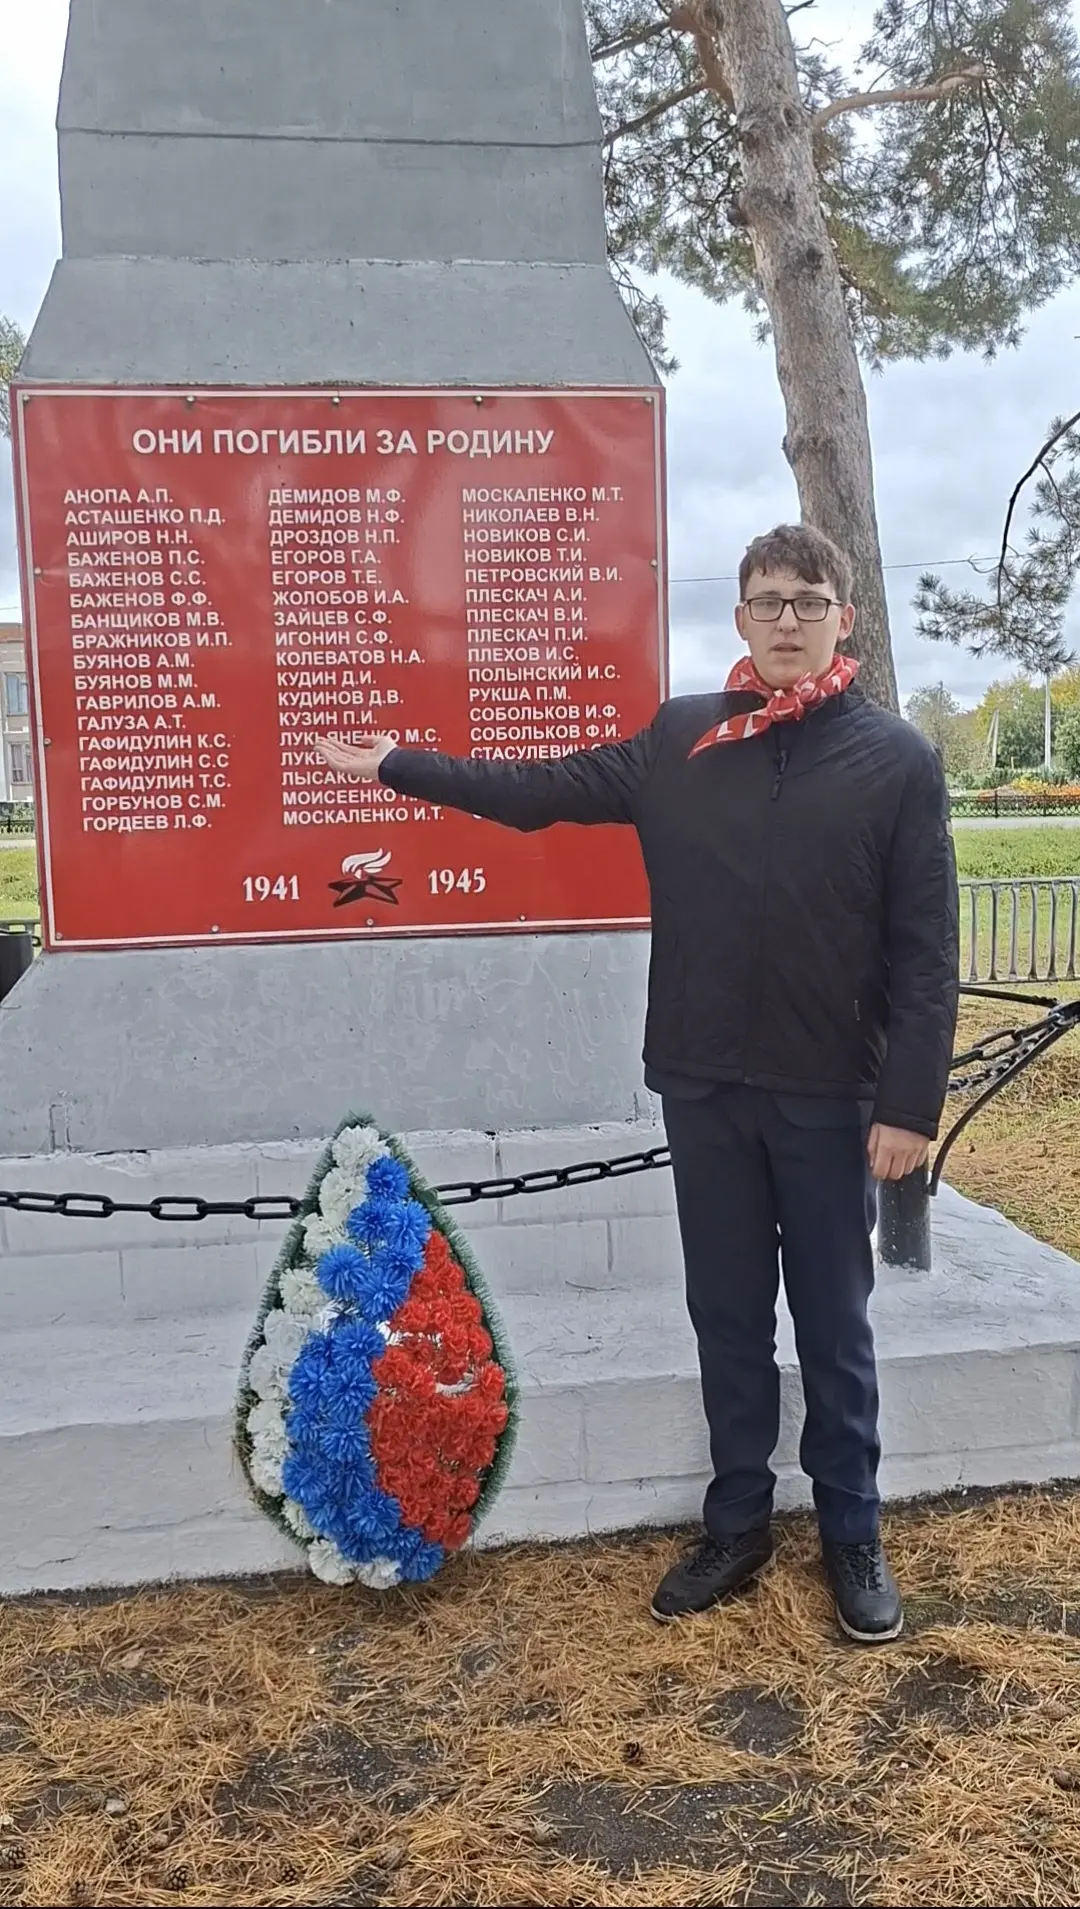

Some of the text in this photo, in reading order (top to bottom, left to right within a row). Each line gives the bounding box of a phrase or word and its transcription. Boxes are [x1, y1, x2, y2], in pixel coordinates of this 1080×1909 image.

[132, 429, 555, 458] ОНИ ПОГИБЛИ ЗА РОДИНУ
[63, 488, 174, 504] АНОПА А.П.
[268, 488, 406, 506] ДЕМИДОВ М.Ф.
[462, 486, 624, 503] МОСКАЛЕНКО М.Т.
[64, 508, 226, 526] АСТАШЕНКО П.Д.
[269, 509, 405, 526] ДЕМИДОВ Н.Ф.
[463, 507, 600, 523] НИКОЛАЕВ В.Н.
[66, 529, 193, 547] АШИРОВ Н.Н.
[270, 529, 400, 547] ДРОЗДОВ Н.П.
[463, 527, 591, 543] НОВИКОВ С.И.
[67, 550, 205, 567] БАЖЕНОВ П.С.
[271, 550, 382, 565] ЕГОРОВ Г.А.
[464, 548, 588, 564] НОВИКОВ Т.И.
[68, 570, 207, 588] БАЖЕНОВ С.С.
[272, 570, 383, 585] ЕГОРОВ Т.Е.
[465, 564, 623, 583] ПЕТРОВСКИЙ В.И.
[70, 591, 212, 608] БАЖЕНОВ Ф.Ф.
[272, 589, 409, 606] ЖОЛОБОВ И.А.
[465, 587, 588, 603] ПЛЕСКАЧ А.И.
[71, 611, 225, 630] БАНЩИКОВ М.В.
[273, 607, 392, 627] ЗАЙЦЕВ С.Ф.
[466, 607, 588, 623] ПЛЕСКАЧ В.И.
[72, 631, 233, 649] БРАЖНИКОВ И.П.
[275, 630, 393, 646] ИГОНИН С.Ф.
[467, 627, 588, 643] ПЛЕСКАЧ П.И.
[73, 653, 195, 670] БУЯНОВ А.М.
[275, 649, 426, 666] КОЛЕВАТОВ Н.А.
[467, 646, 580, 663] ПЛЕХОВ И.С.
[74, 673, 199, 690] БУЯНОВ М.М.
[277, 670, 377, 688] КУДИН Д.И.
[467, 663, 621, 683] ПОЛЫНСКИЙ И.С.
[75, 693, 221, 711] ГАВРИЛОВ А.М.
[278, 689, 405, 708] КУДИНОВ Д.В.
[469, 686, 572, 702] РУКША П.М.
[279, 710, 378, 727] КУЗИН П.И.
[469, 704, 621, 722] СОБОЛЬКОВ И.Ф.
[77, 714, 186, 731] ГАЛУЗА А.Т.
[279, 728, 442, 747] ЛУКЬЯНЕО М.С.
[470, 723, 621, 742] СОБОЛЬКОВ Ф.И.
[78, 733, 232, 753] ГАФИДУЛИН К.С.
[80, 753, 229, 773] ГАФИДУЛИН С.С
[81, 773, 232, 793] ГАФИДУЛИН Т.С.
[82, 793, 226, 812] ГОРБУНОВ С.М.
[282, 788, 397, 806] МОИСЕЕНКО
[83, 813, 212, 833] ГОРДЕЕВ Л.Ф.
[283, 806, 445, 825] МОСКАЛЕНКО И.Т.
[242, 874, 301, 902] 1941
[427, 867, 487, 895] 1945
